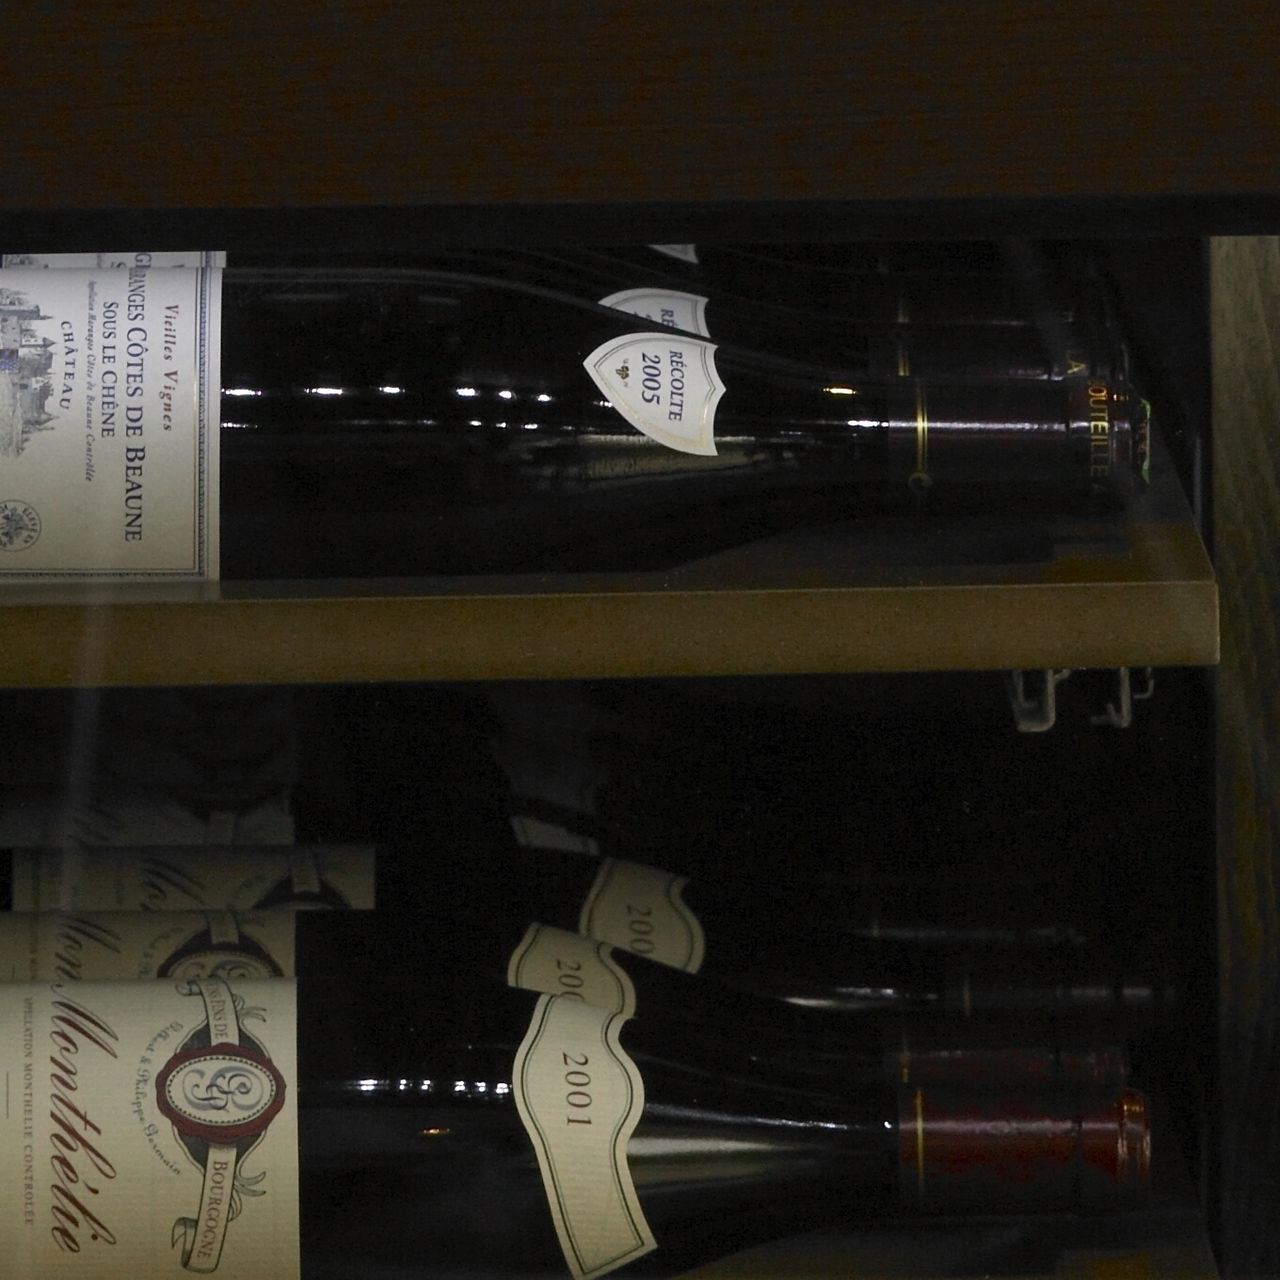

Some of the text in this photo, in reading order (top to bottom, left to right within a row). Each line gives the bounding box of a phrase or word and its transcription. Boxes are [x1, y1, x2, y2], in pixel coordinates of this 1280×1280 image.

[59, 320, 79, 411] CHÂTEAU
[99, 300, 121, 439] SOUS LE CHÊNE
[158, 303, 180, 432] Vieilles Vignes
[640, 351, 663, 406] 2005
[667, 349, 688, 423] RÉCOLTE
[123, 326, 150, 544] CÔTES DE BEAUNE
[48, 989, 120, 1255] Monthélie
[561, 1050, 590, 1127] 2001
[197, 1159, 231, 1259] BOURGOGNE
